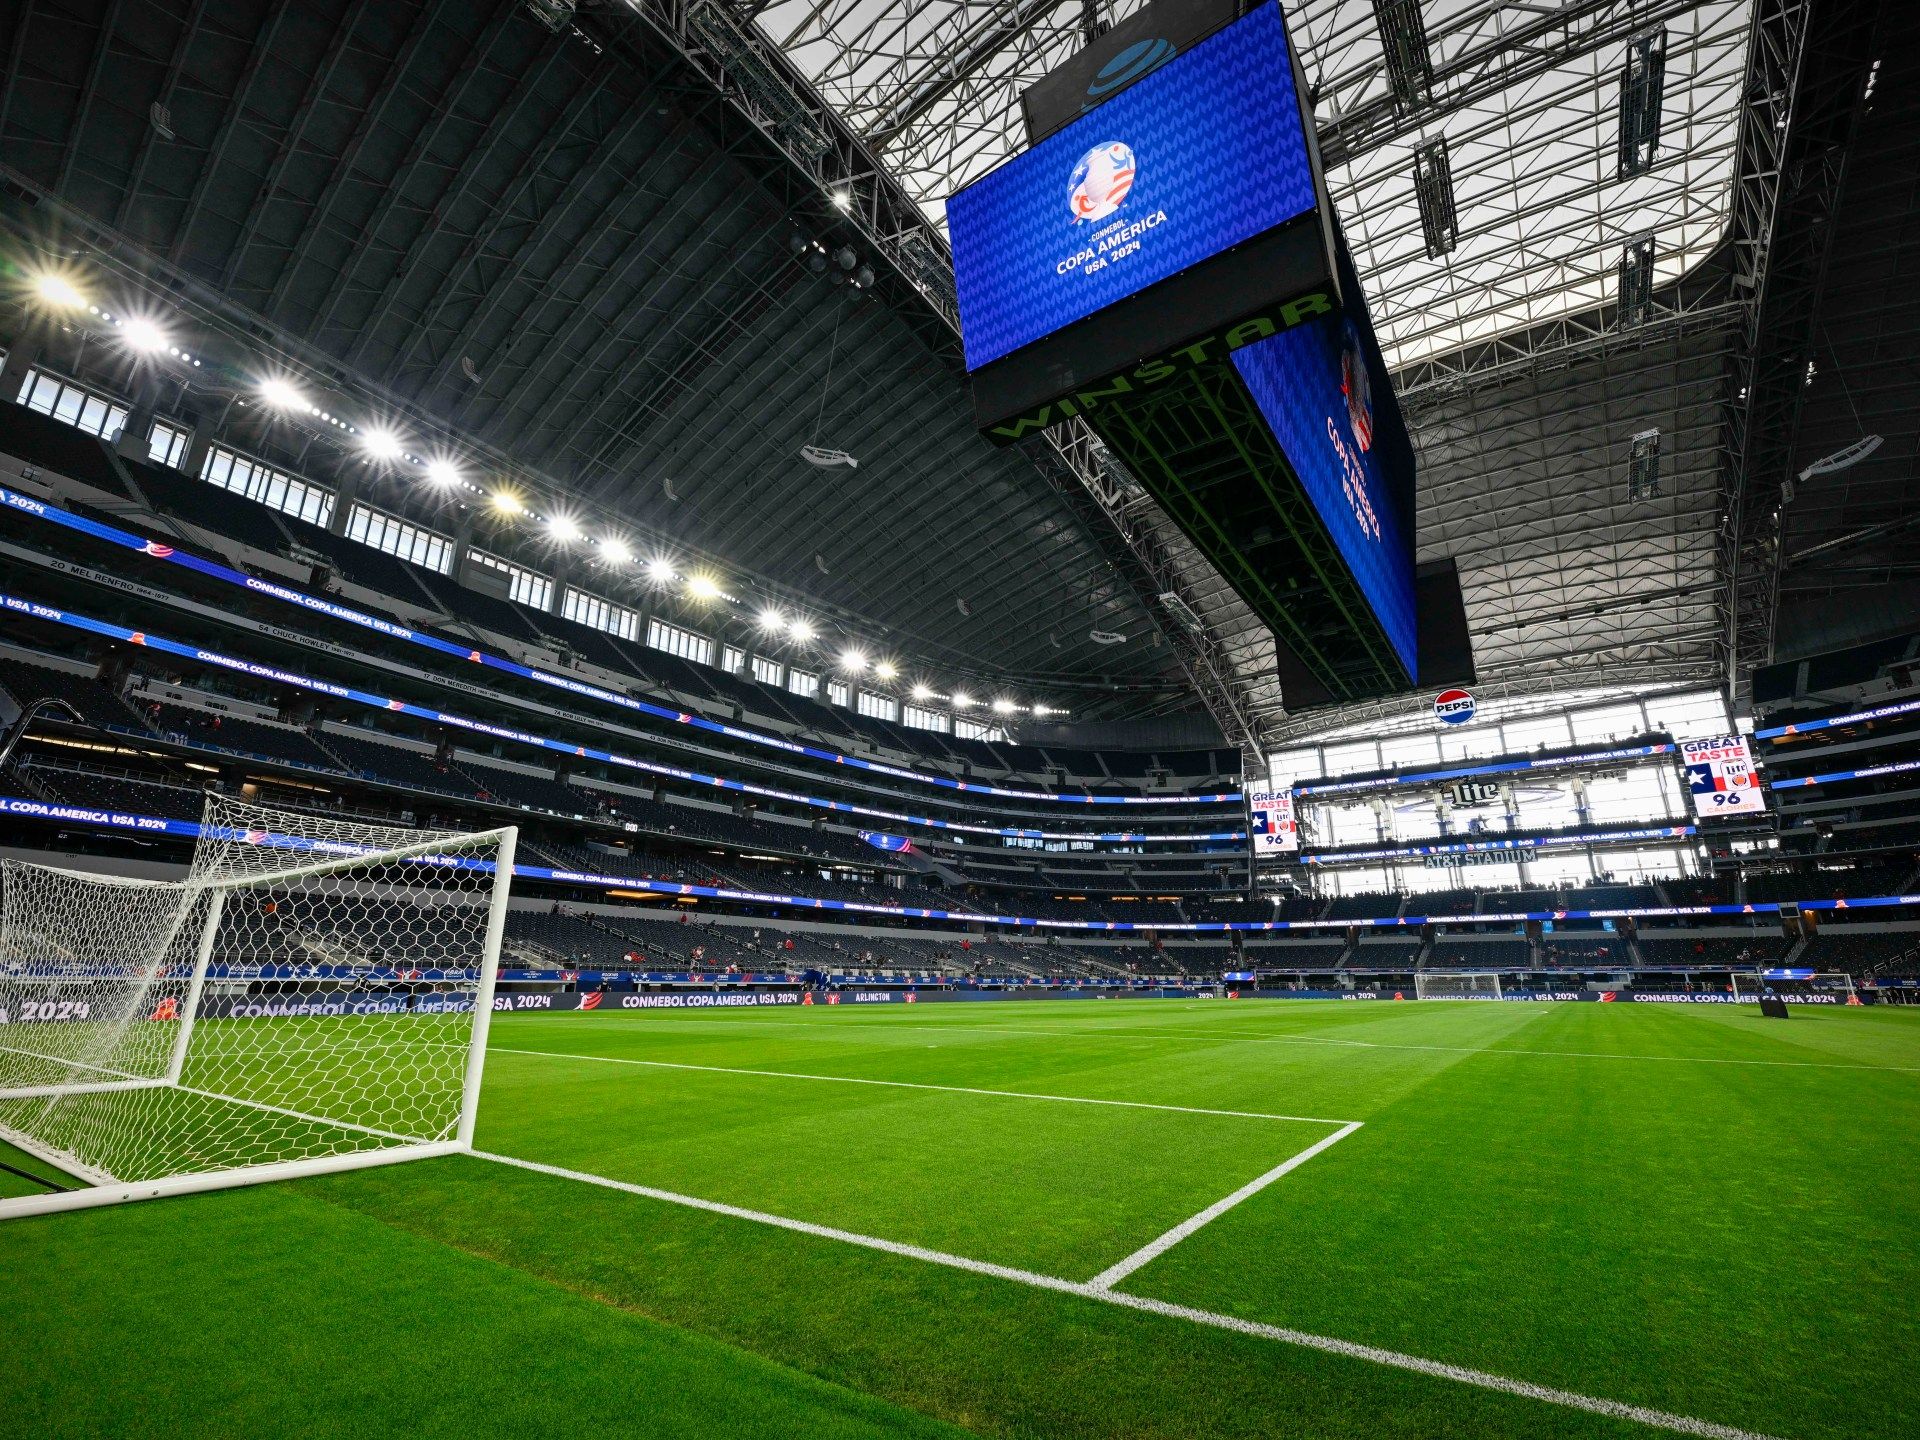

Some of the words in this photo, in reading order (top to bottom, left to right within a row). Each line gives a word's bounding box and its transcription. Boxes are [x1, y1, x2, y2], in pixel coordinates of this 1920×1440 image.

[1091, 218, 1126, 243] CONMEBOL
[1056, 247, 1096, 275] COPA
[1097, 210, 1168, 255] AMERICA
[1084, 257, 1108, 275] USA
[1110, 240, 1141, 262] 2024
[991, 293, 1333, 438] WINSTAR
[1327, 416, 1350, 476] COPA
[1350, 468, 1381, 543] AMERICA
[9, 493, 45, 515] 2024
[50, 560, 65, 571] 20
[70, 566, 91, 578] MEL
[94, 573, 134, 591] RENFRO
[7, 598, 29, 612] USA
[32, 604, 61, 620] 2024
[247, 578, 303, 604] CONMEBOL
[305, 597, 330, 613] COPA
[330, 605, 372, 626] AMERICA
[374, 620, 390, 632] USA
[391, 625, 412, 639] 2024
[273, 629, 298, 641] CHUCK
[300, 637, 330, 650] HOWLEY
[198, 651, 249, 671] CONMEBOL
[250, 665, 273, 677] COPA
[274, 671, 311, 687] AMERICA
[313, 681, 328, 692] USA
[330, 685, 348, 697] 2024
[1436, 700, 1474, 713] PEPSI
[1828, 711, 1876, 726] CONMEBOL
[1876, 706, 1900, 716] COPA
[1684, 736, 1743, 752] GREAT
[1531, 758, 1565, 766] CONMEBOL
[1584, 752, 1612, 760] AMERICA
[1687, 747, 1745, 762] TASTE
[1854, 766, 1895, 778] CONMEBOL
[1895, 762, 1916, 771] COPA
[1252, 791, 1290, 801] GREAT
[1451, 783, 1498, 807] Lite
[1713, 792, 1741, 806] 96
[1254, 800, 1290, 809] TASTE
[10, 801, 48, 815] COPA
[49, 806, 108, 823] AMERICA
[112, 814, 135, 826] USA
[138, 818, 166, 830] 2024
[1266, 835, 1283, 845] 96
[1546, 836, 1582, 844] CONMEBOL
[1425, 855, 1461, 869] AT&T
[1464, 849, 1537, 866] STADIUM
[552, 872, 585, 881] CONMEBOL
[491, 997, 514, 1011] SA
[517, 995, 551, 1008] 2024
[622, 995, 685, 1008] CONMEBOL
[687, 995, 715, 1007] COPA
[715, 995, 757, 1006] AMERICA
[759, 994, 776, 1004] USA
[778, 993, 798, 1003] 2024
[856, 992, 890, 1002] ARLINGTON
[1535, 993, 1554, 1002] USA
[1555, 992, 1578, 1000] 2024
[1633, 994, 1694, 1003] CONMEBOL
[1695, 994, 1726, 1003] COPA
[1780, 994, 1805, 1004] USA
[1806, 994, 1837, 1003] 2024
[21, 1001, 90, 1020] 2024
